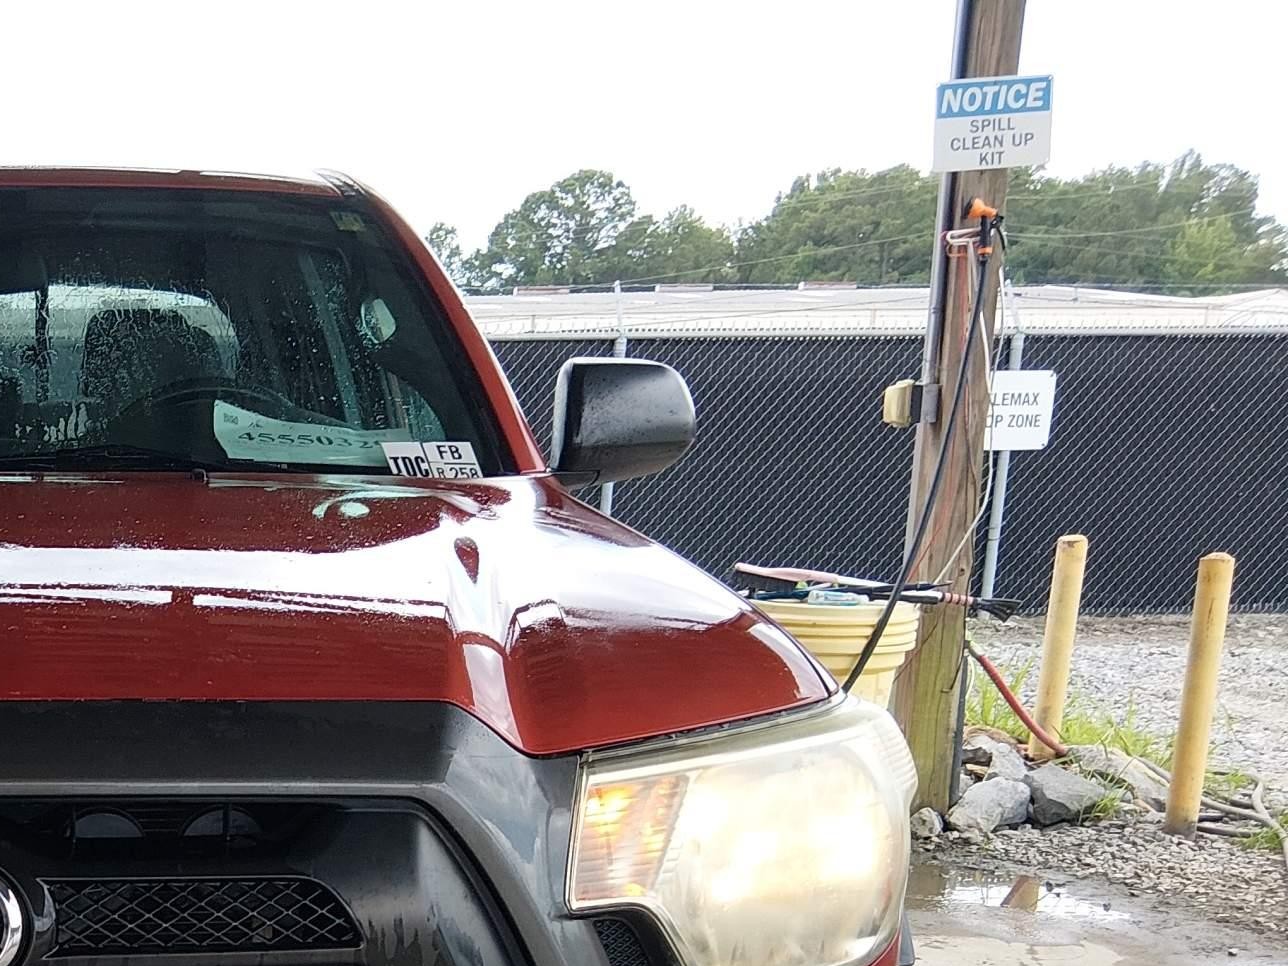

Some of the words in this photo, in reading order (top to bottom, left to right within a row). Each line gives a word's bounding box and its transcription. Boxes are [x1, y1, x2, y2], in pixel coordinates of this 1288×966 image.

[941, 81, 1047, 115] NOTICE
[969, 117, 1016, 133] SPILL
[950, 134, 1004, 151] CLEAN
[1011, 132, 1034, 148] UP
[978, 150, 1006, 166] KIT
[989, 391, 1041, 407] LEMAX
[1008, 414, 1042, 428] ZONE
[436, 445, 463, 460] FB
